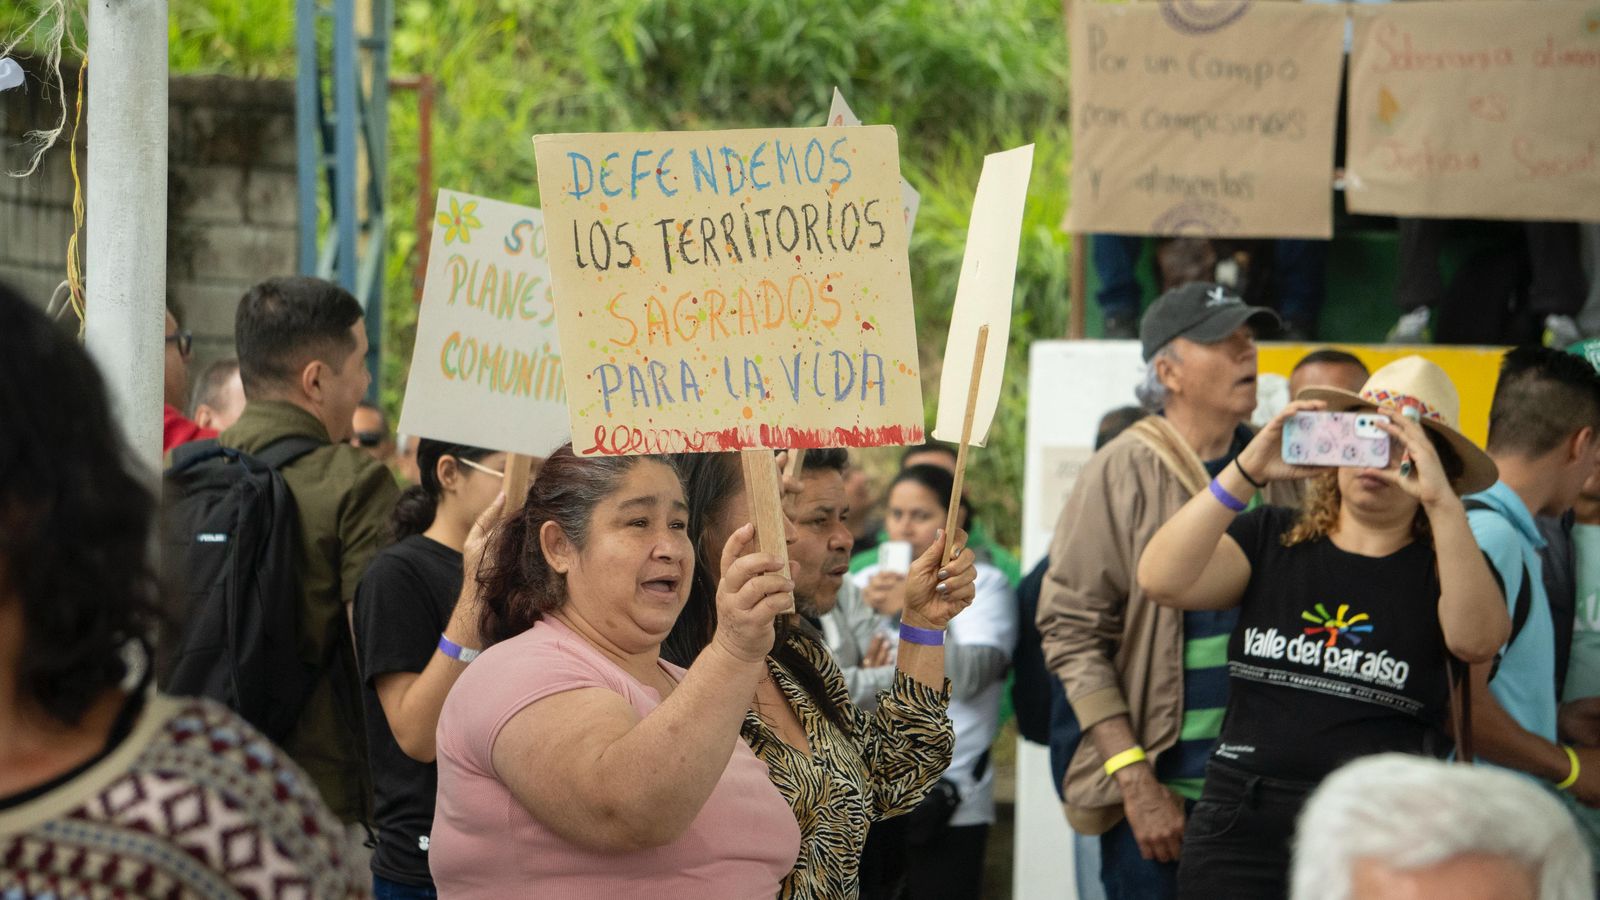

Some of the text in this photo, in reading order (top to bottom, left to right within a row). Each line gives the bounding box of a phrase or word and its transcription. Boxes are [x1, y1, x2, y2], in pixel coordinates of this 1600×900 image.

[567, 136, 853, 200] DEFENDEMOS
[572, 192, 886, 274] LOS TERRITORIOS
[609, 272, 844, 347] SAGRADOS
[592, 341, 887, 413] PARA LA VIDA
[1244, 627, 1287, 660] Valle
[1287, 633, 1324, 667] del
